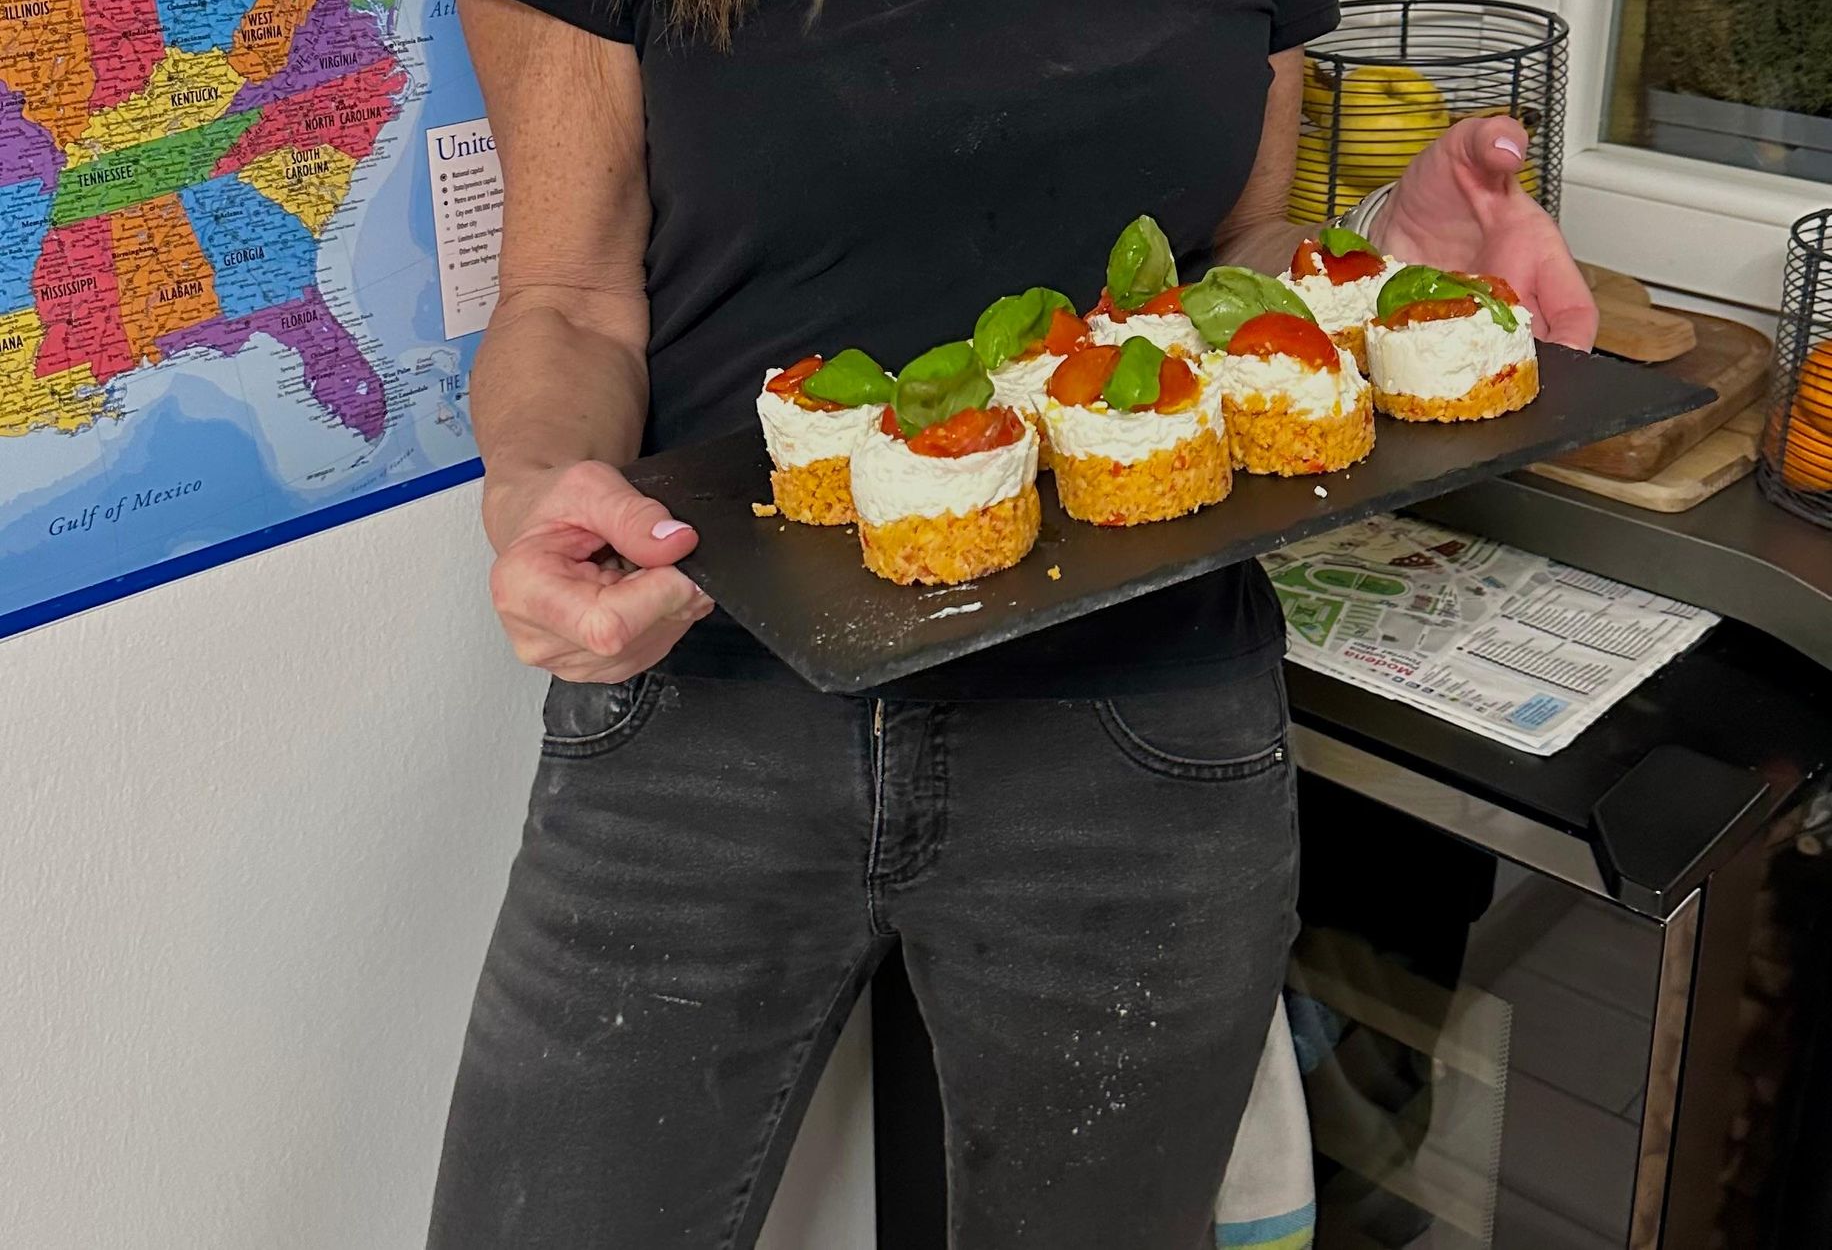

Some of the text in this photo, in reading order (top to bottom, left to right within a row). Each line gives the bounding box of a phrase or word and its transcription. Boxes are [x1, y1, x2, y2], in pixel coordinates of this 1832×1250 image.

[5, 0, 50, 21] ILLINOIS
[248, 11, 273, 27] WEST
[241, 25, 283, 43] VIRGINIA
[393, 38, 416, 48] Virginia
[319, 52, 359, 70] VIRGINIA
[171, 87, 219, 107] KENTUCKY
[305, 107, 382, 132] NORTH CAROLINA
[291, 148, 320, 165] SOUTH
[436, 132, 496, 162] Unite
[77, 165, 134, 188] TENNESSEE
[285, 161, 330, 180] CAROLINA
[455, 209, 465, 219] City
[457, 220, 468, 230] Other
[223, 246, 266, 267] GEORGIA
[459, 244, 471, 256] Other
[38, 276, 98, 302] MISSISSIPPI
[159, 281, 204, 303] ALABAMA
[281, 309, 319, 330] FLORIDA
[440, 374, 460, 393] THE
[49, 480, 203, 536] Gulf of Mexico
[1344, 650, 1415, 676] Modena
